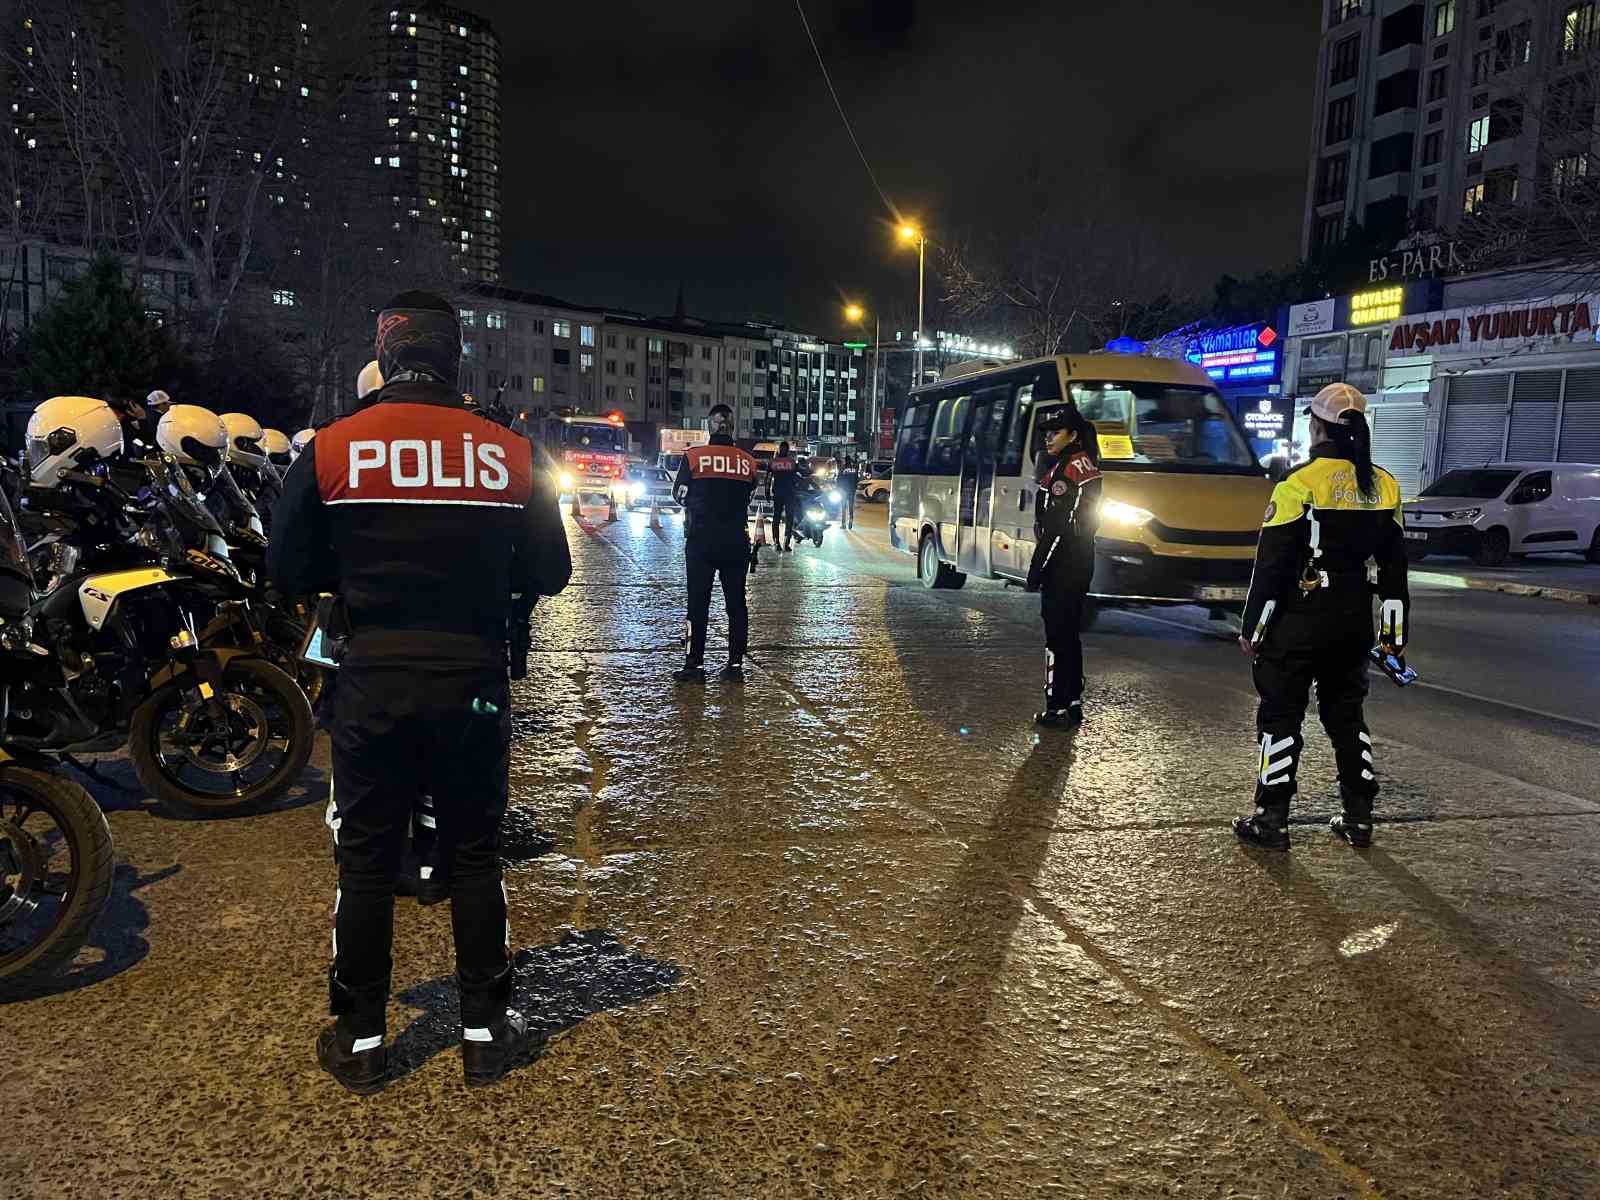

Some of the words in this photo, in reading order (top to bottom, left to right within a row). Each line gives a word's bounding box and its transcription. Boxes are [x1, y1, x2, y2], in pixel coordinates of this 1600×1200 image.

[1351, 287, 1403, 309] BOYASIZ
[1389, 318, 1461, 353] AVŞAR
[1467, 302, 1591, 342] YUMURTA
[349, 433, 509, 490] POLİS
[699, 455, 750, 476] POLİS
